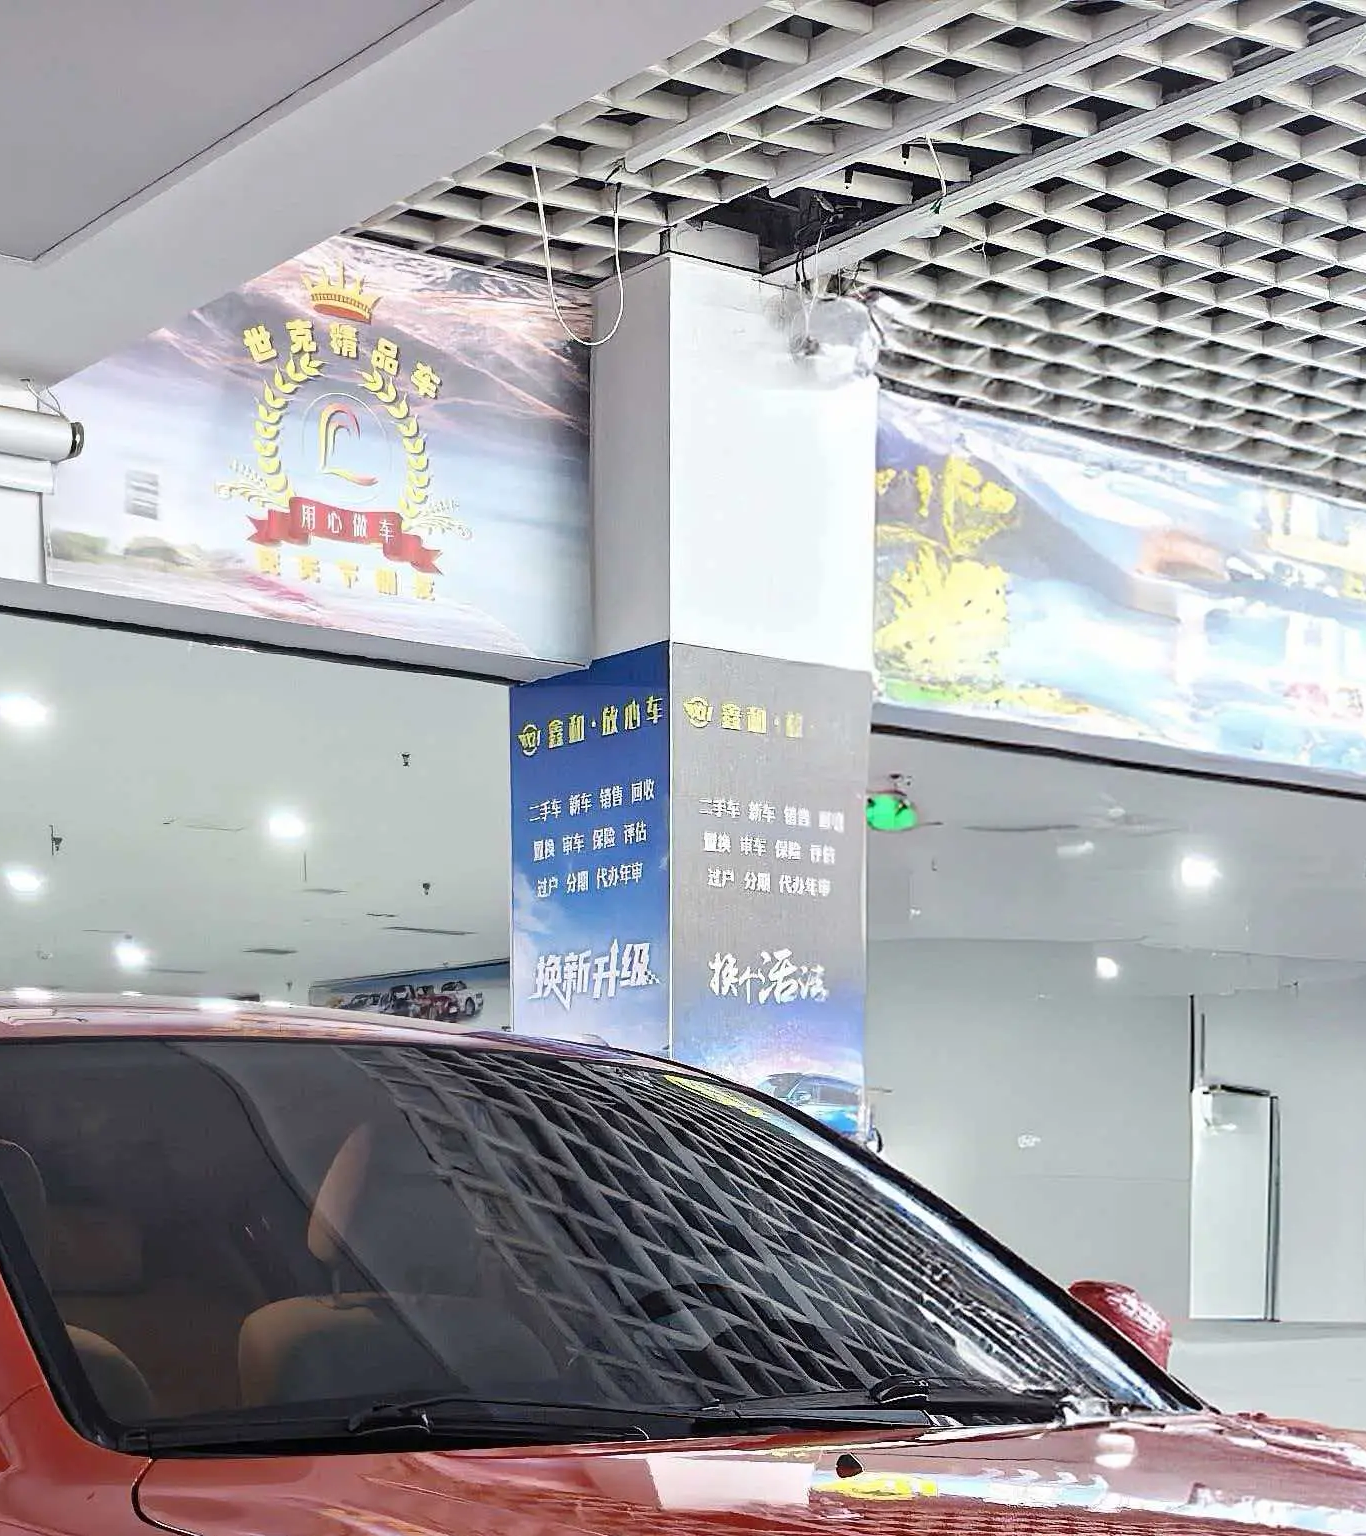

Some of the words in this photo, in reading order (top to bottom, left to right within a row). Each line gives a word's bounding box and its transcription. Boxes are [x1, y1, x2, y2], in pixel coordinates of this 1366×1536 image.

[529, 799, 562, 821] 二手车
[569, 793, 592, 816] 新车
[600, 786, 623, 809] 销售
[631, 779, 655, 804] 回收
[699, 798, 740, 819] 二手车
[748, 800, 776, 823] 新车
[593, 827, 615, 850] 保险
[624, 820, 647, 844] 评估
[537, 876, 558, 898] 过户
[567, 870, 589, 893] 分期
[597, 862, 643, 889] 代办年审
[707, 867, 735, 888] 过户
[528, 938, 659, 1010] 换新升级
